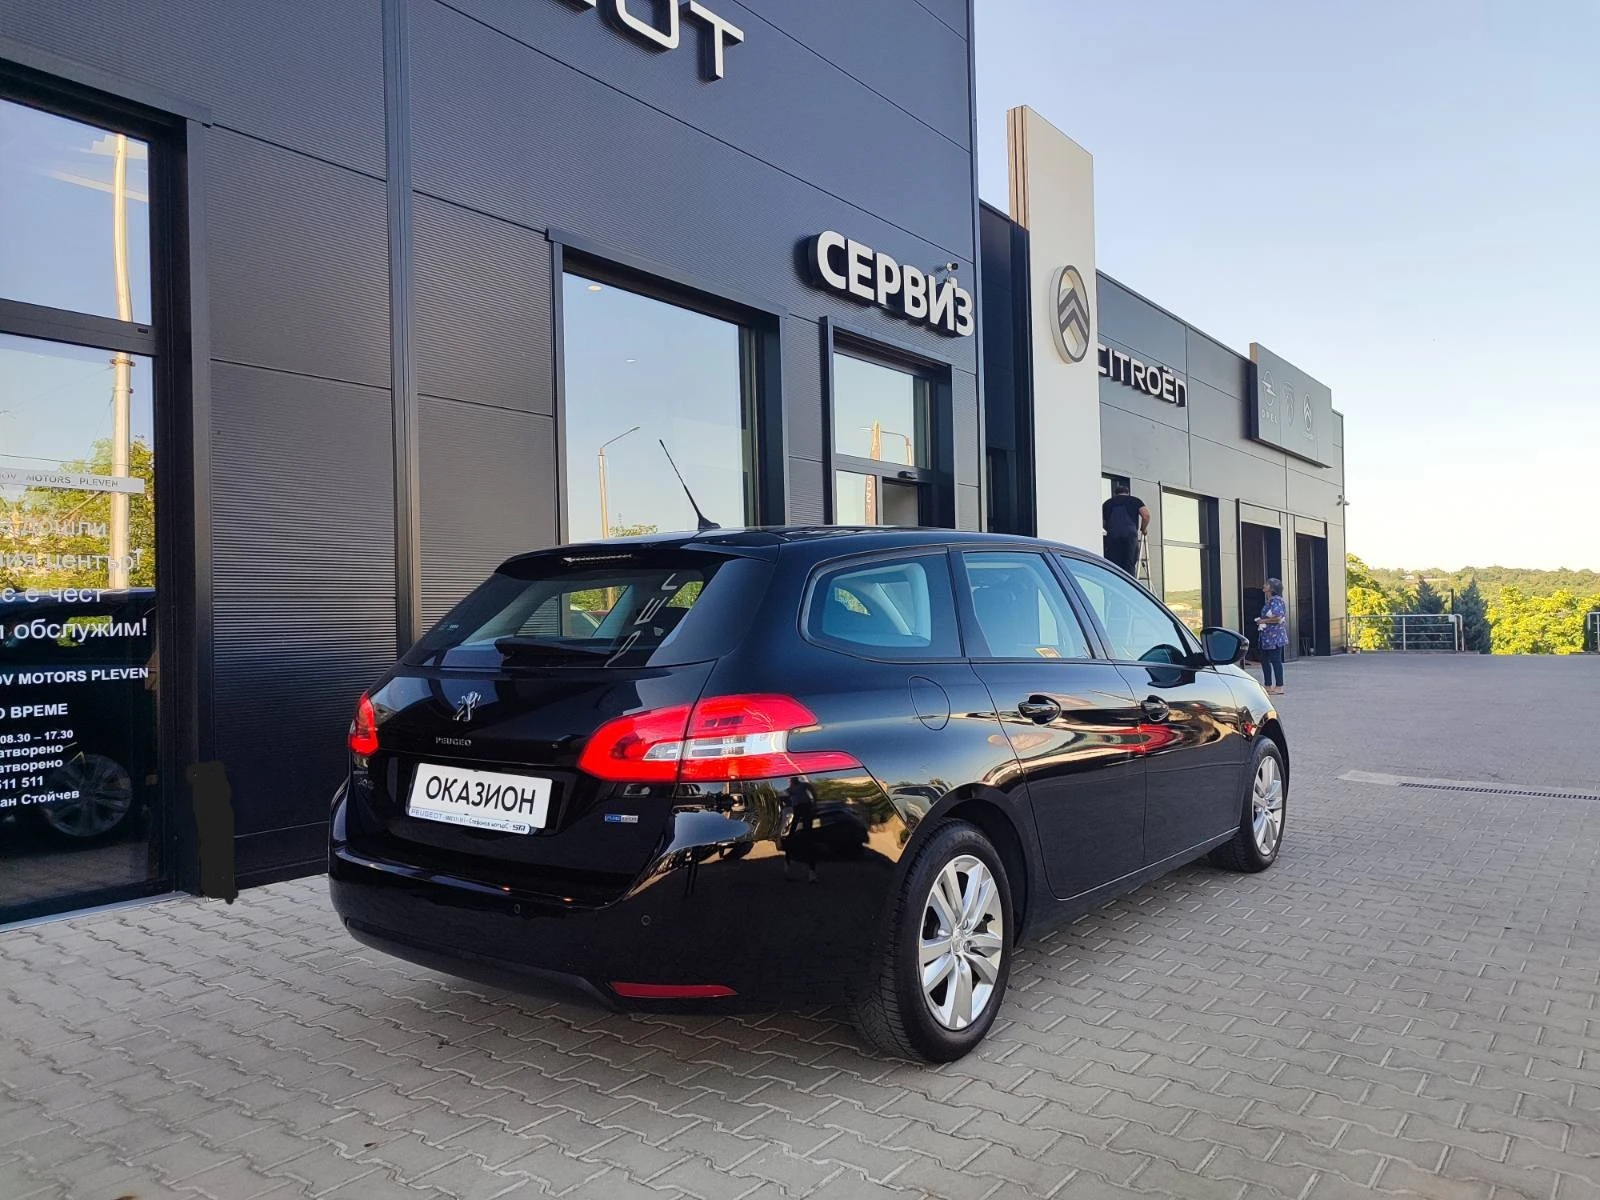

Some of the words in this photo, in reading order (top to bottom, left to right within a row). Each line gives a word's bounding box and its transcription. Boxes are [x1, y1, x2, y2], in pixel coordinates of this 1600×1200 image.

[817, 230, 974, 337] СЕРВИЗ
[79, 477, 119, 488] PLEVEN
[24, 587, 40, 603] е
[49, 587, 102, 603] чест
[14, 618, 148, 643] обслужим!
[18, 670, 87, 685] MOTORS
[91, 667, 149, 681] PLEVEN
[10, 703, 69, 719] ВРЕМЕ
[0, 733, 31, 744] 08.30
[44, 729, 74, 741] 17.30
[0, 778, 16, 790] 11
[21, 775, 44, 788] 511
[21, 790, 80, 805] Стойчев
[425, 775, 536, 815] ОКАЗИОН
